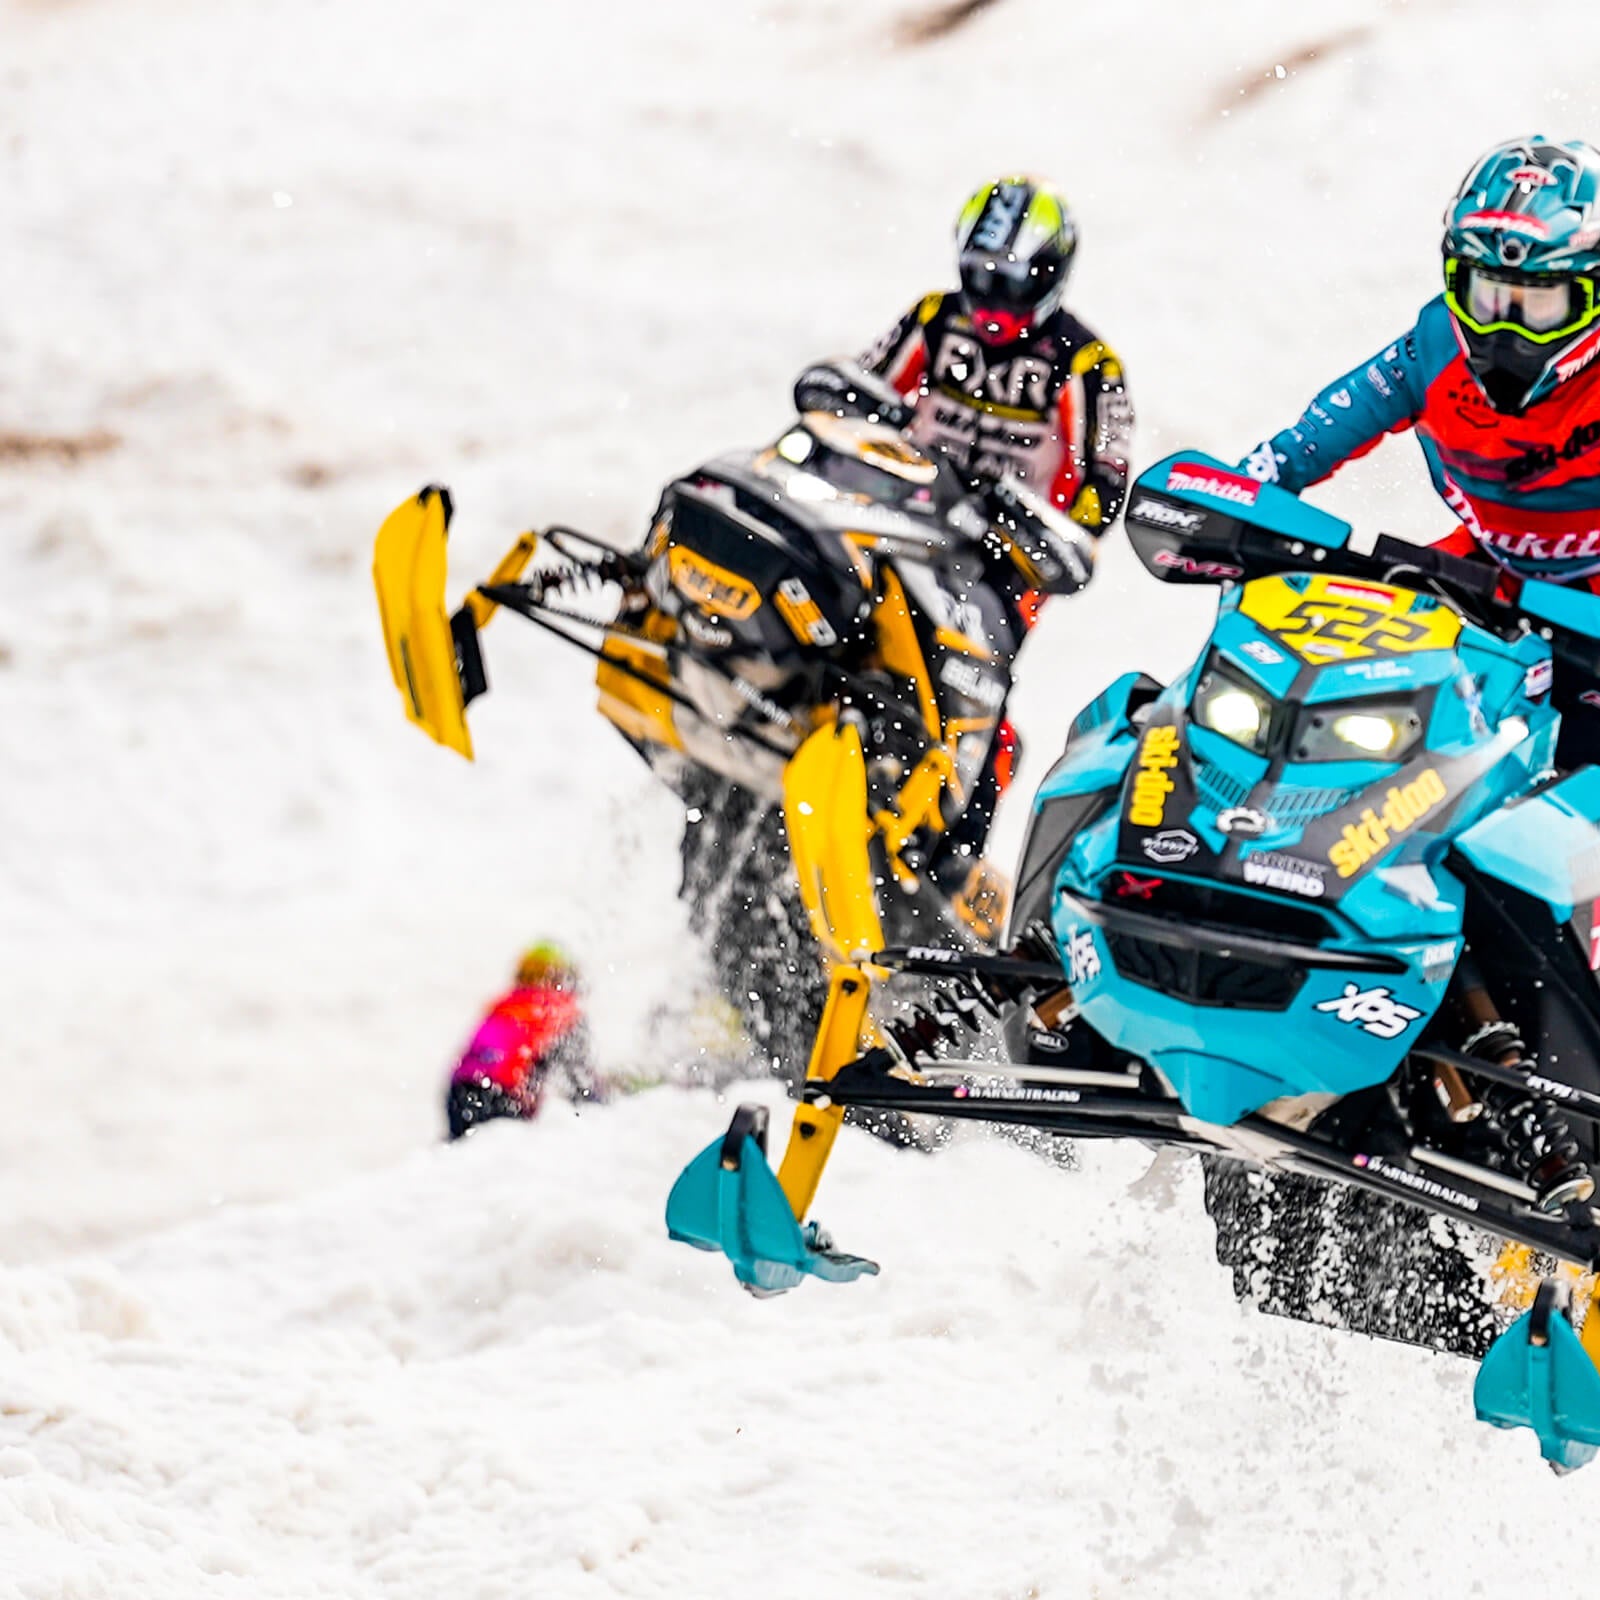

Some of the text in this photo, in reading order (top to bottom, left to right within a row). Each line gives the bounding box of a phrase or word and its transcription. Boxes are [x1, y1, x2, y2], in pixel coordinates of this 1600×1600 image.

[934, 333, 1050, 408] FXR
[1166, 472, 1256, 507] makita
[1274, 600, 1430, 653] 522
[1129, 725, 1180, 827] ski-doo
[1328, 768, 1447, 879] ski-doo
[1243, 862, 1326, 898] WEIRD
[1315, 983, 1423, 1039] XPS
